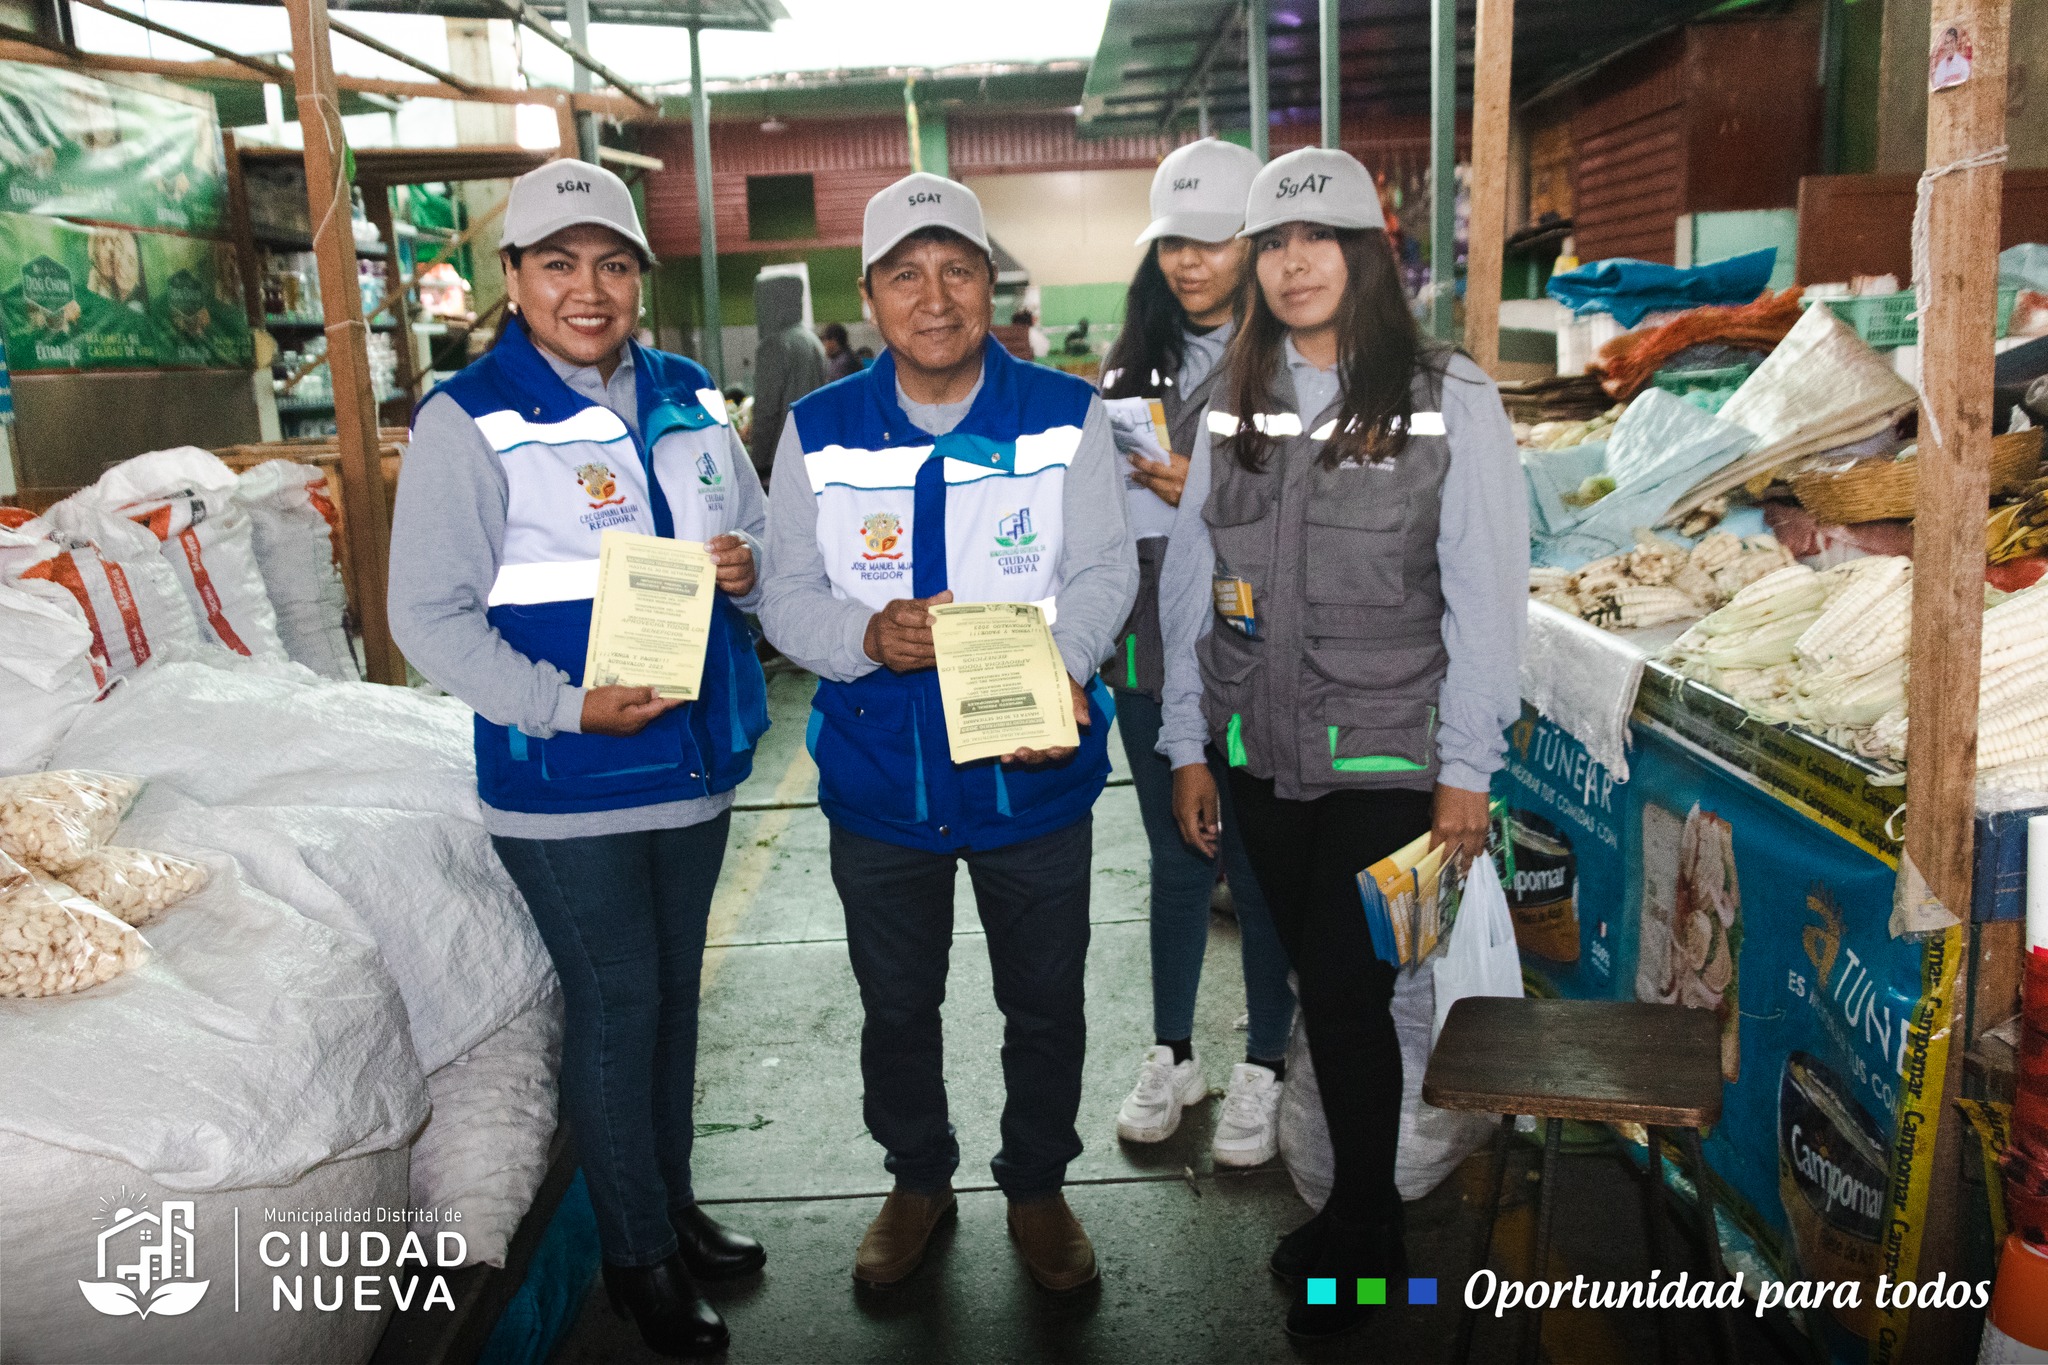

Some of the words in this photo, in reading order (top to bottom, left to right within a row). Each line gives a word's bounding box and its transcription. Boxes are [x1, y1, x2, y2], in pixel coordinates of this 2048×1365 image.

[556, 180, 591, 194] SGAT
[1173, 178, 1200, 191] SGAT
[908, 192, 942, 206] SGAT
[589, 513, 636, 531] REGIDORA
[851, 562, 866, 570] JOSE
[869, 562, 895, 570] MANUEL
[998, 554, 1040, 566] CIUDAD
[861, 571, 903, 580] REGIDOR
[1003, 564, 1037, 575] NUEVA
[1788, 969, 1806, 997] ES
[1908, 997, 1943, 1100] Campomar
[1894, 1110, 1925, 1212] Campomar
